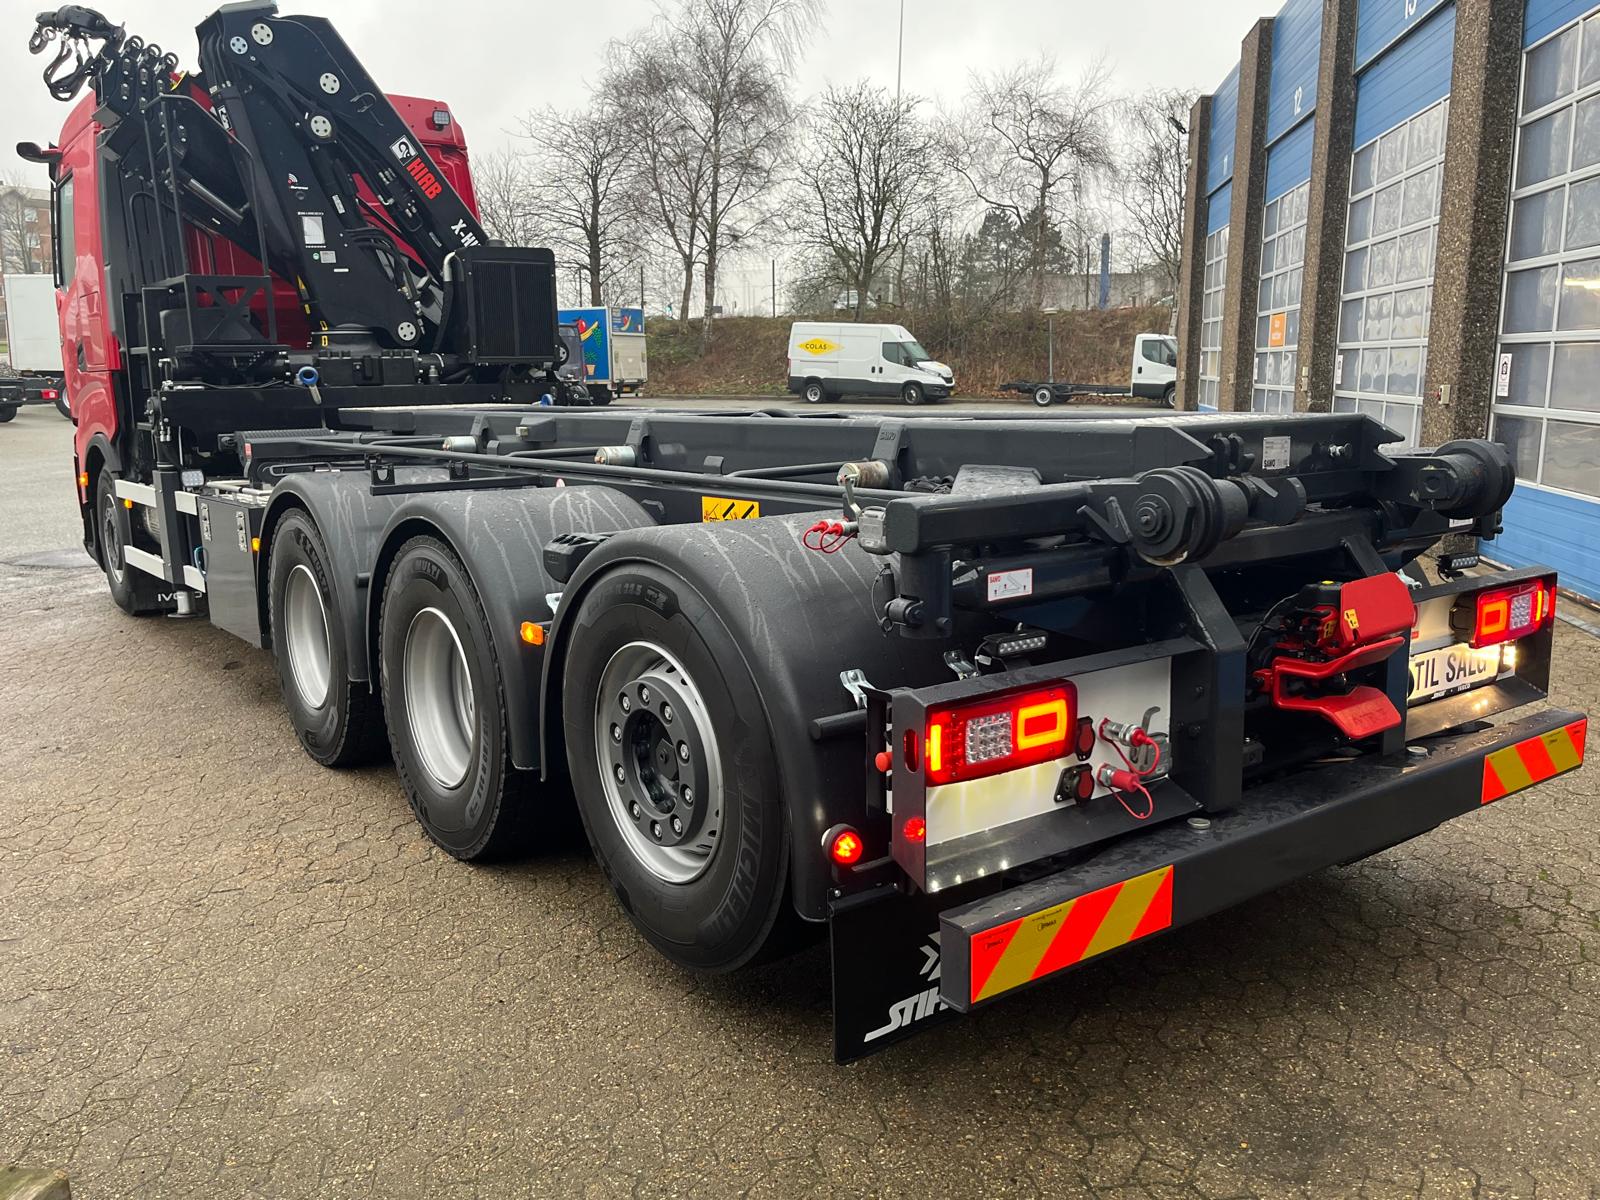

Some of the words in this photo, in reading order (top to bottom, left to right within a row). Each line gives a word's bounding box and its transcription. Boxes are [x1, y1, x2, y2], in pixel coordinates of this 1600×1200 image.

[1294, 86, 1302, 116] 12
[406, 157, 443, 200] HIAB
[1415, 657, 1439, 691] TIL
